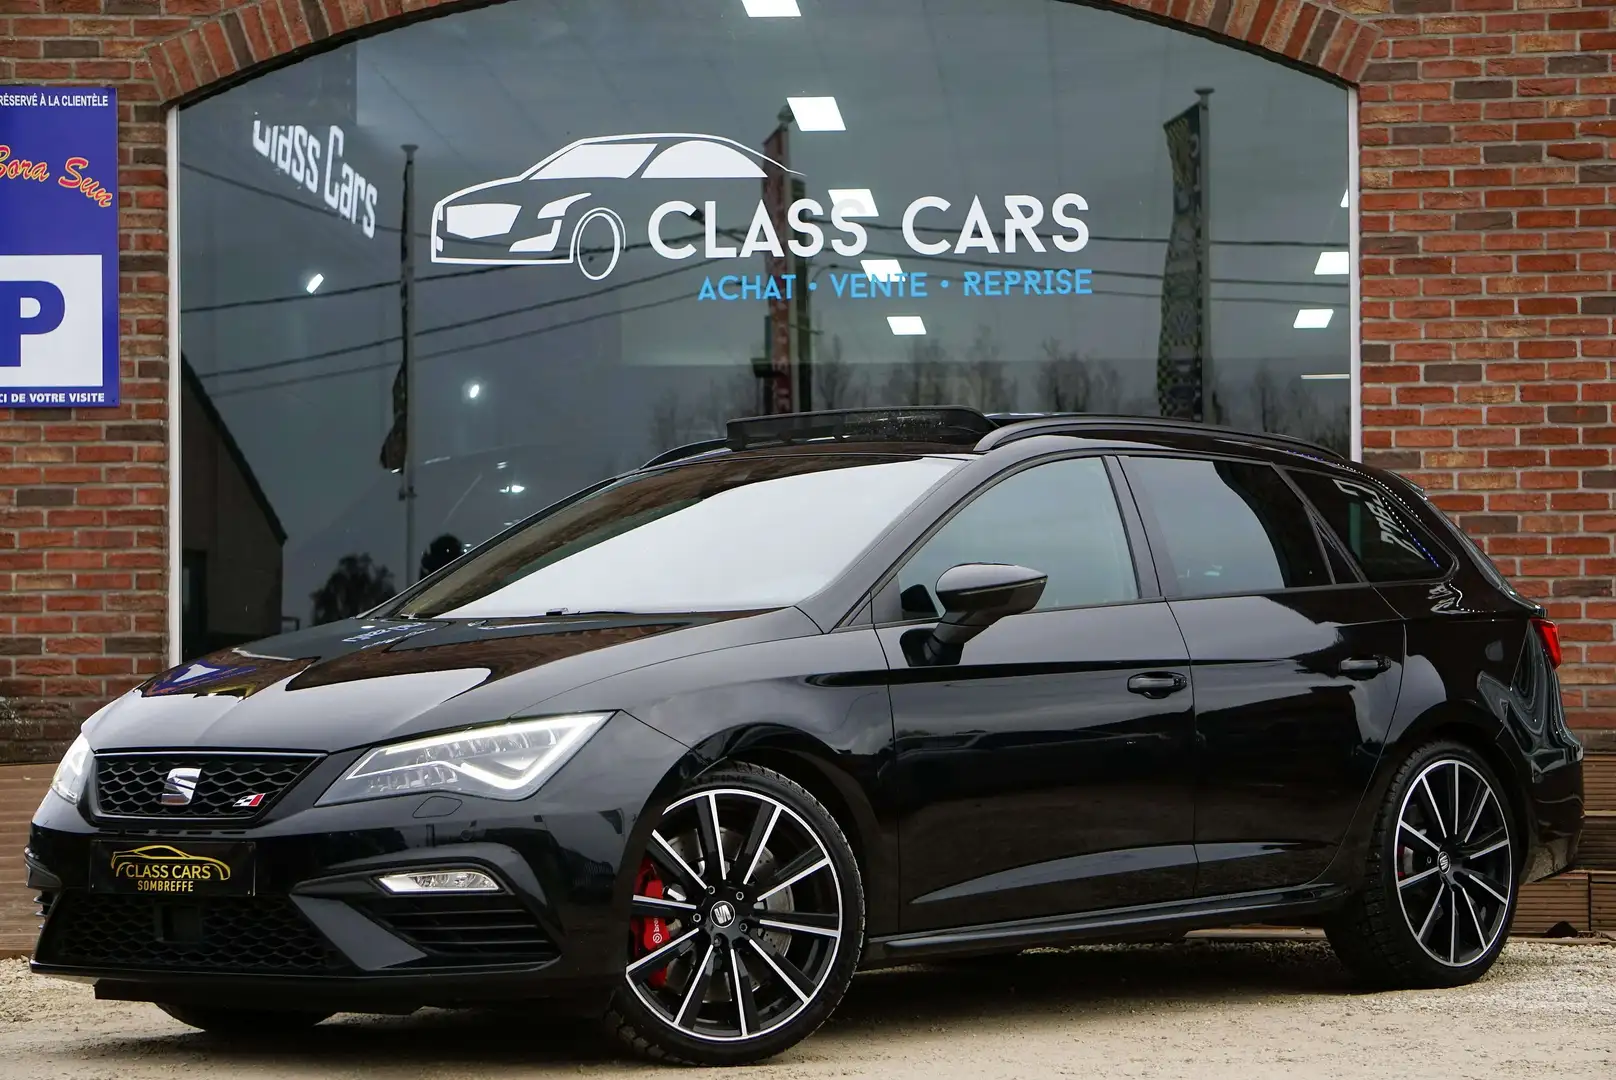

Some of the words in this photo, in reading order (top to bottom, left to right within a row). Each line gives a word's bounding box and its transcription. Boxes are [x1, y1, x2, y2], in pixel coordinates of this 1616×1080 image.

[0, 93, 38, 107] RÉSERVÉ
[40, 93, 47, 107] À
[48, 95, 60, 107] LA
[62, 93, 109, 107] CLIENTÈLE
[58, 157, 113, 207] Sun
[324, 125, 378, 239] Cars
[648, 198, 868, 260] CLASS
[902, 193, 1089, 255] CARS
[698, 274, 797, 301] ACHAT
[830, 272, 928, 299] VENTE
[963, 269, 1093, 297] REPRISE
[0, 281, 65, 367] P
[11, 393, 26, 403] DE
[29, 393, 66, 403] VOTRE
[69, 393, 105, 403] VISITE
[126, 864, 169, 879] CLASS
[172, 864, 212, 879] CARS
[137, 880, 194, 892] SOMBREFFE
